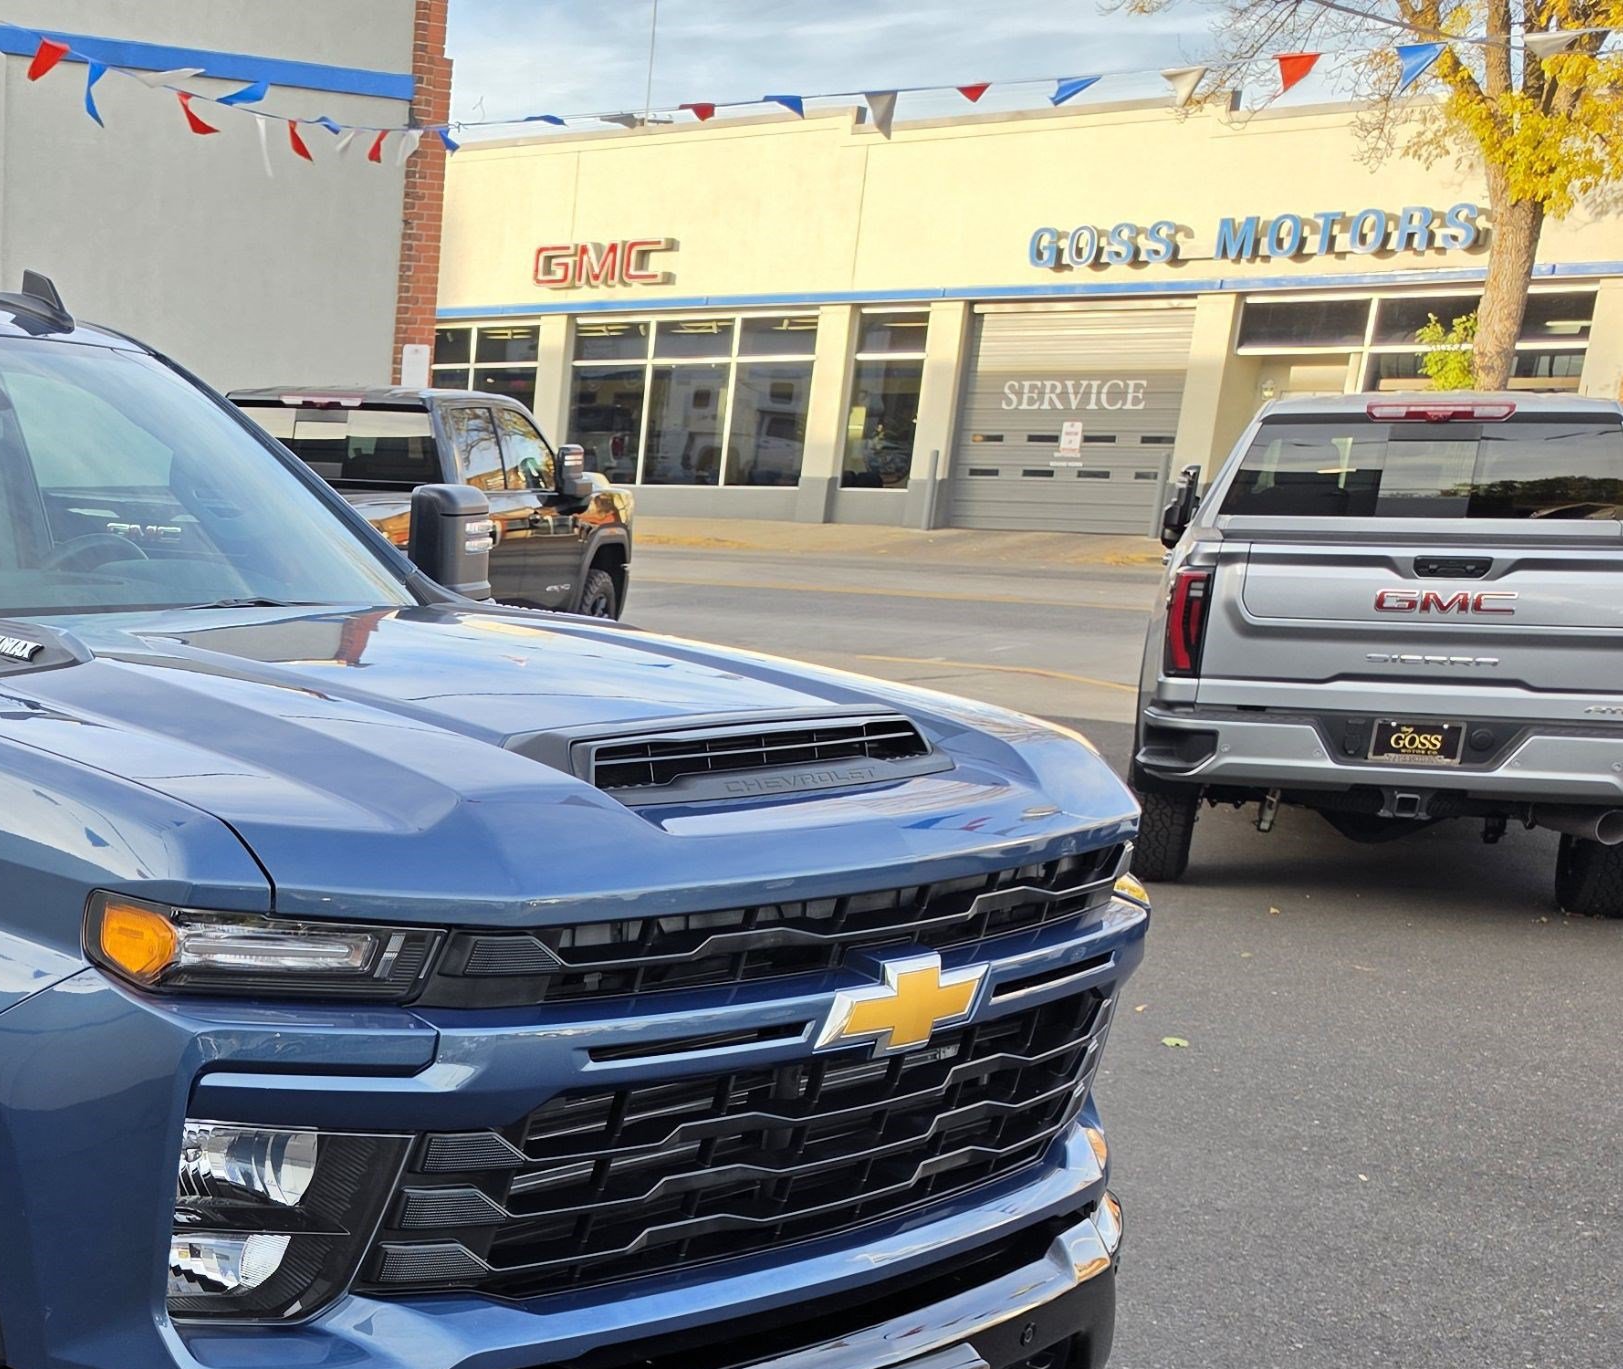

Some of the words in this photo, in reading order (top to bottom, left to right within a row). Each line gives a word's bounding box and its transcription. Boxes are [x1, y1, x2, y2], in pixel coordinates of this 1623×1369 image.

[1029, 221, 1176, 268] GOSS
[1214, 203, 1479, 260] MOTORS
[533, 239, 677, 289] GMC
[1002, 379, 1147, 411] SERVICE
[1374, 588, 1519, 616] GMC
[1365, 653, 1500, 667] SIERRA
[1390, 733, 1443, 750] GOSS
[724, 767, 876, 794] CHEVROLET
